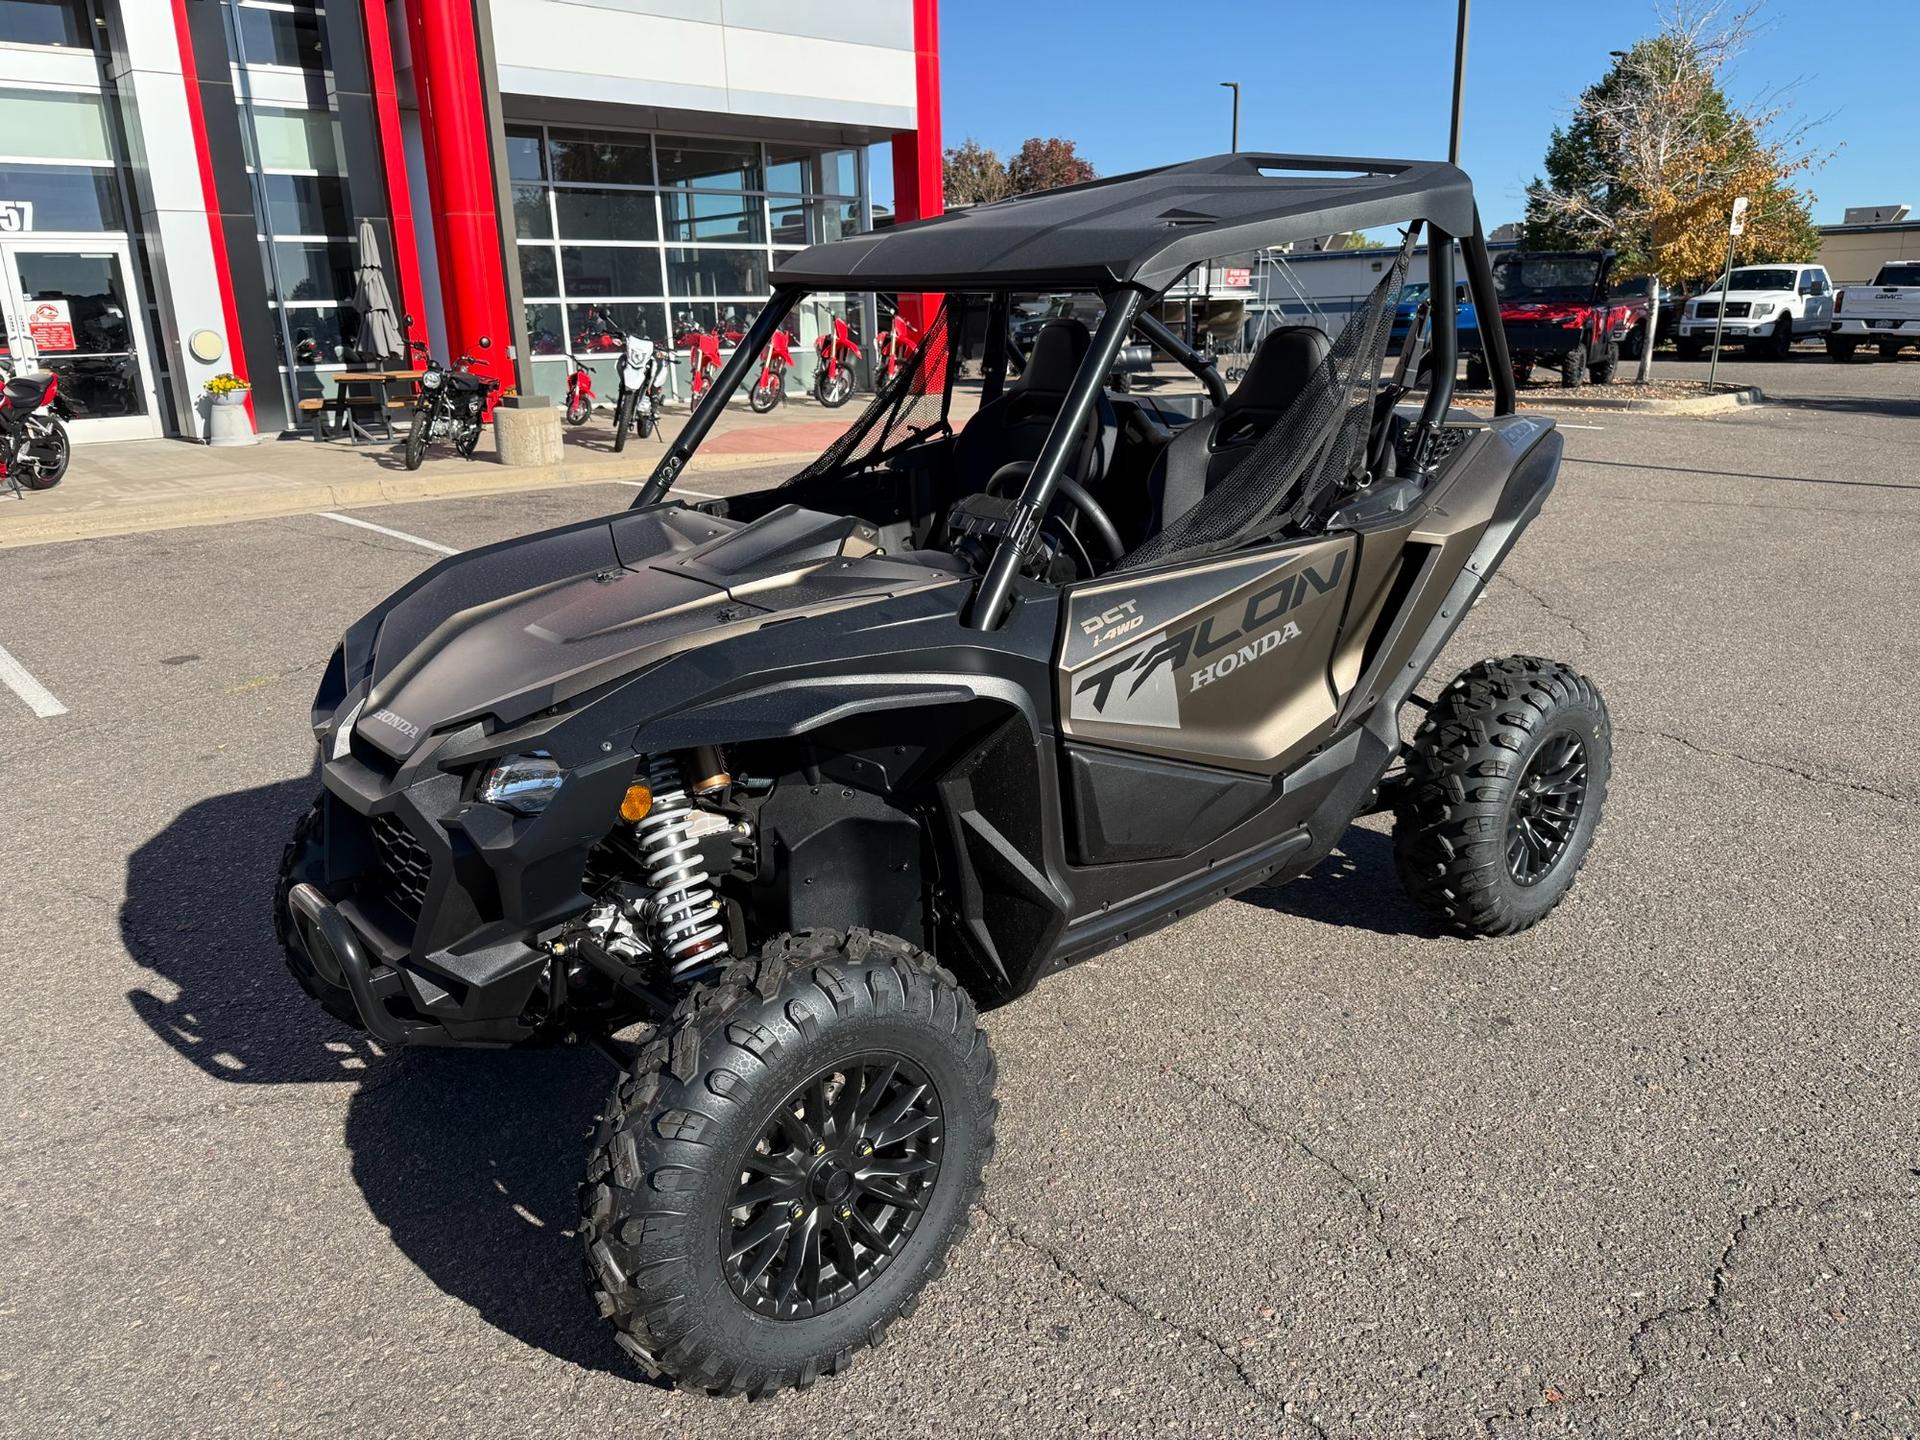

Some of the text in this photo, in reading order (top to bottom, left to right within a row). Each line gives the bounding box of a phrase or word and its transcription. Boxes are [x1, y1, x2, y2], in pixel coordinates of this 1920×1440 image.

[1075, 549, 1349, 714] TALON
[1080, 599, 1136, 634] DCT
[1190, 620, 1302, 693] HONDA
[372, 709, 420, 739] HONDA
